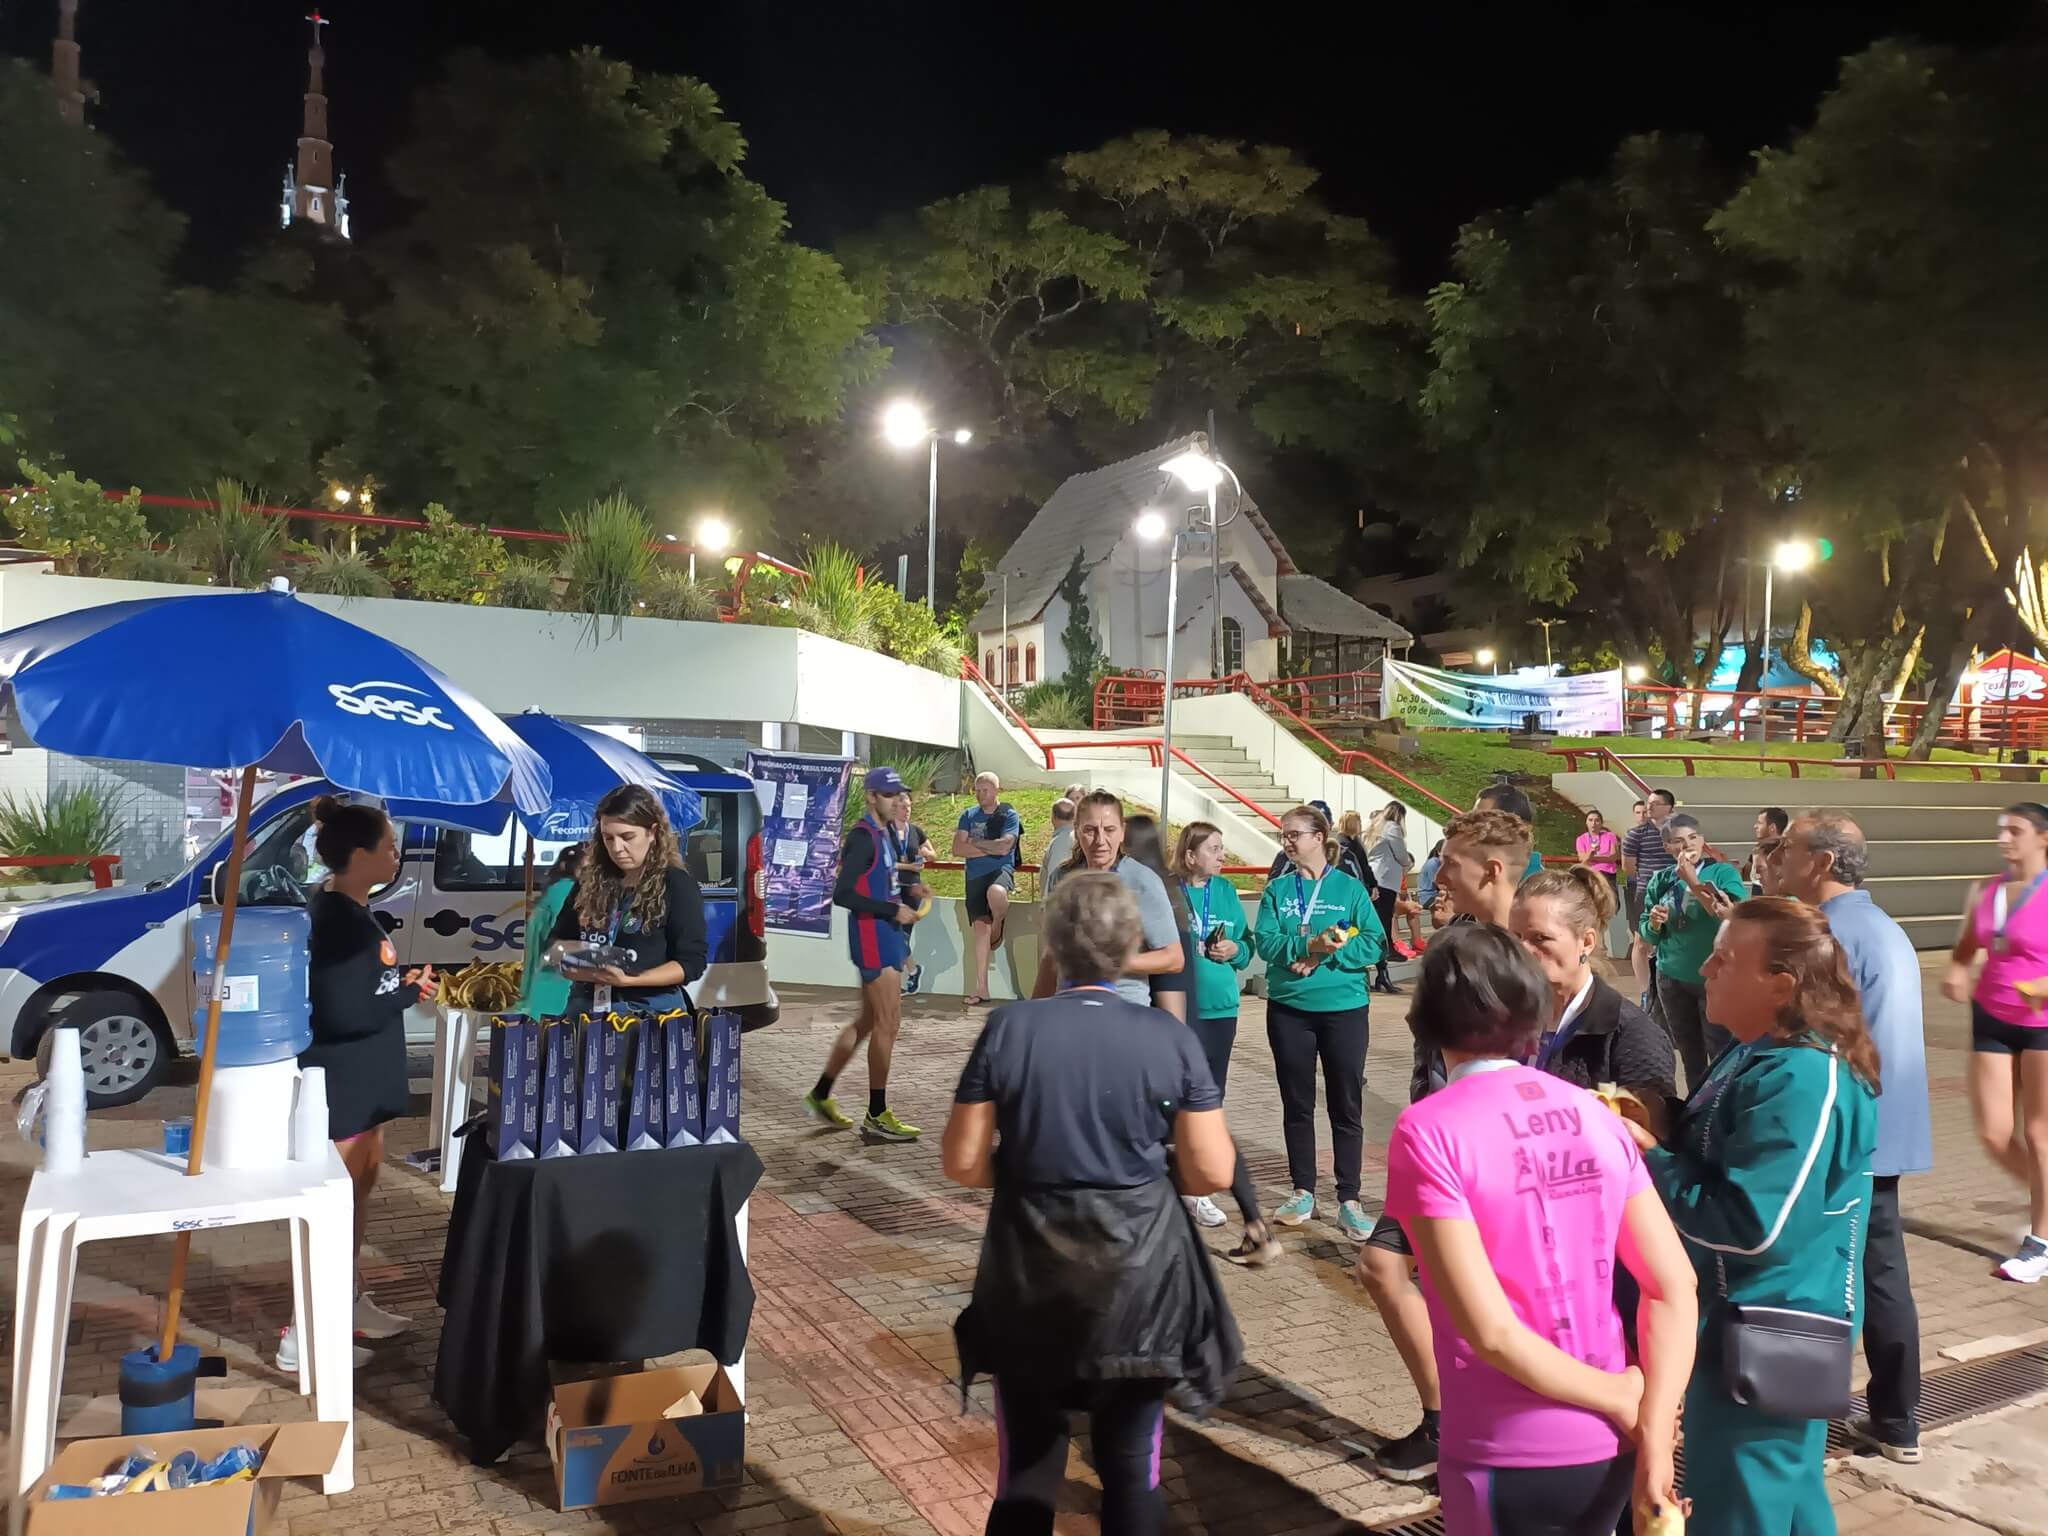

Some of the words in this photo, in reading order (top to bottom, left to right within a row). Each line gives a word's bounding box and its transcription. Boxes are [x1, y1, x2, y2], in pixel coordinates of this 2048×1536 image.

[1987, 673, 2026, 690] eskmo
[1396, 693, 1408, 703] De
[1409, 694, 1420, 703] 30
[1502, 1106, 1583, 1140] Leny
[611, 1468, 654, 1485] FONTE
[668, 1461, 698, 1477] ILHA
